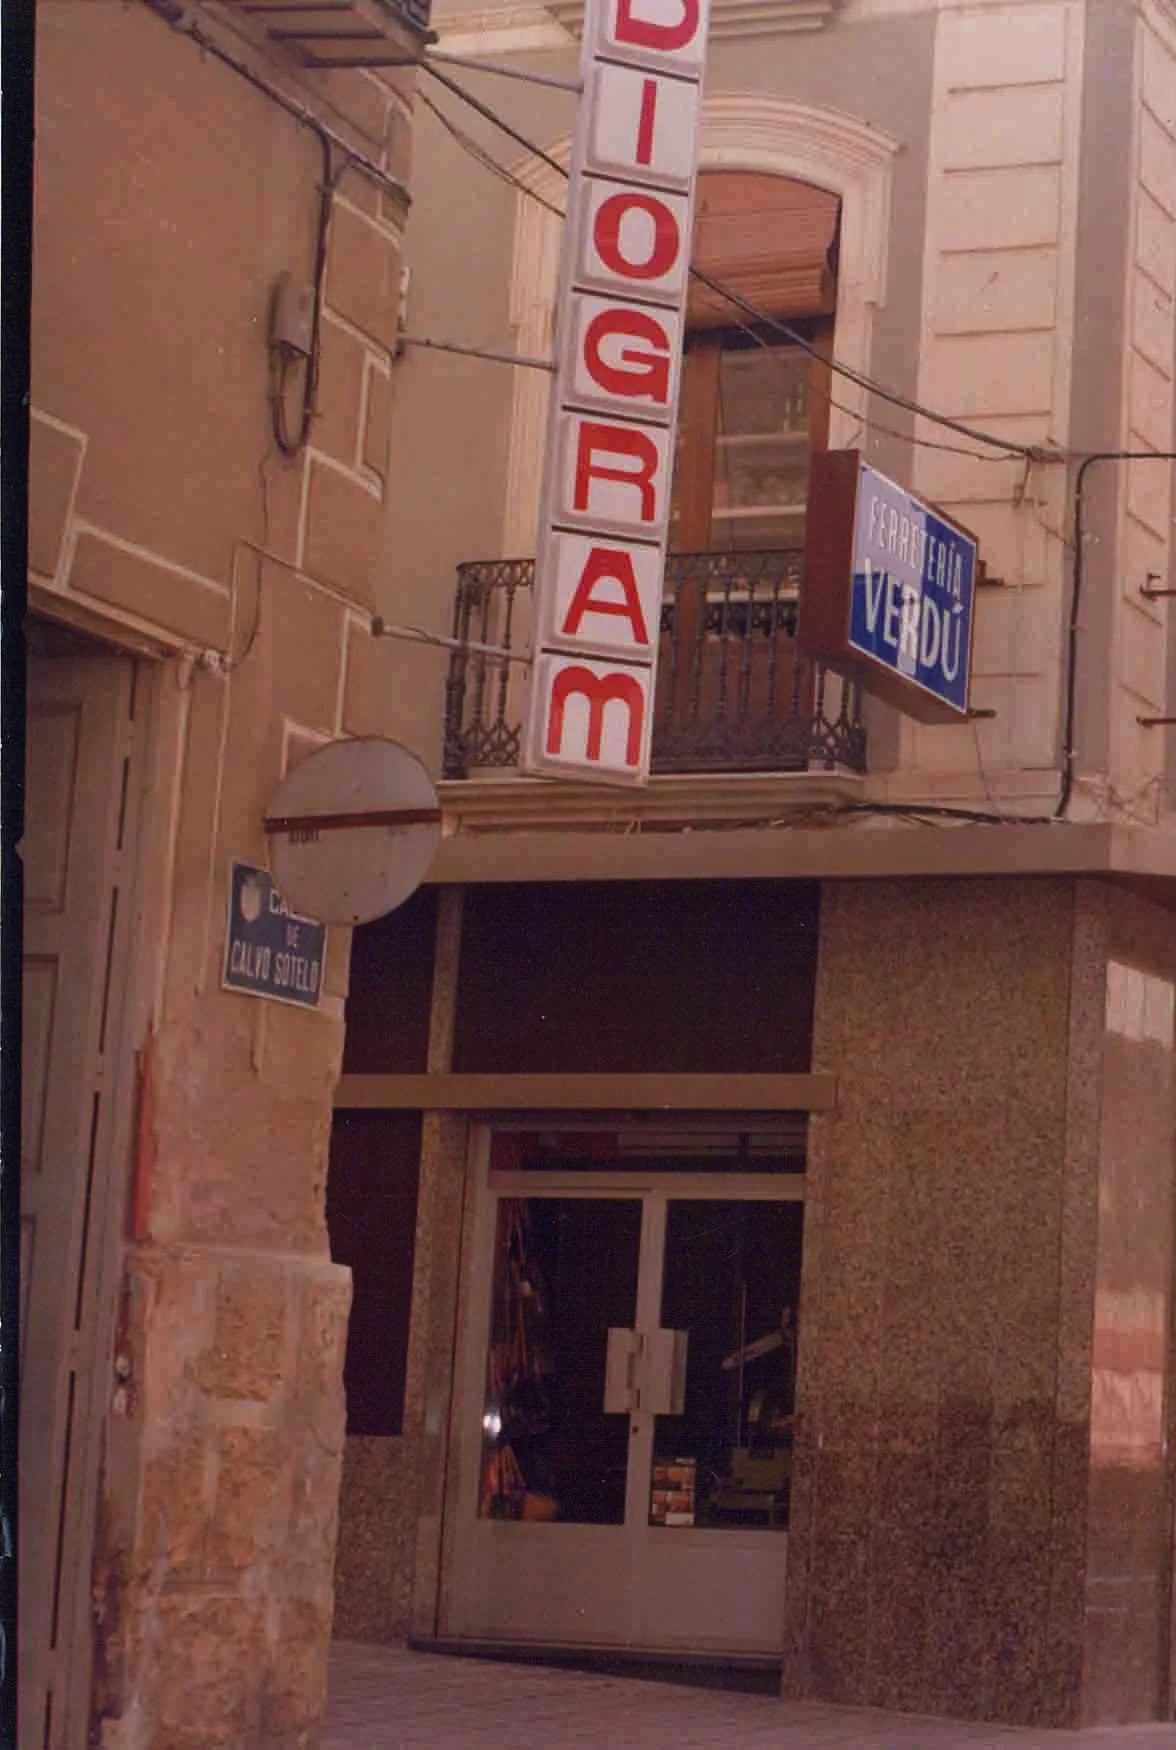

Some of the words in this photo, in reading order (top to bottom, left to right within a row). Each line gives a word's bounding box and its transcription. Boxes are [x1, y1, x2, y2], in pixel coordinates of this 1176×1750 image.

[868, 497, 963, 602] FERRETERÍA
[863, 557, 965, 682] VERDÚ
[230, 939, 271, 981] CALVO
[274, 951, 320, 993] SOTELO
